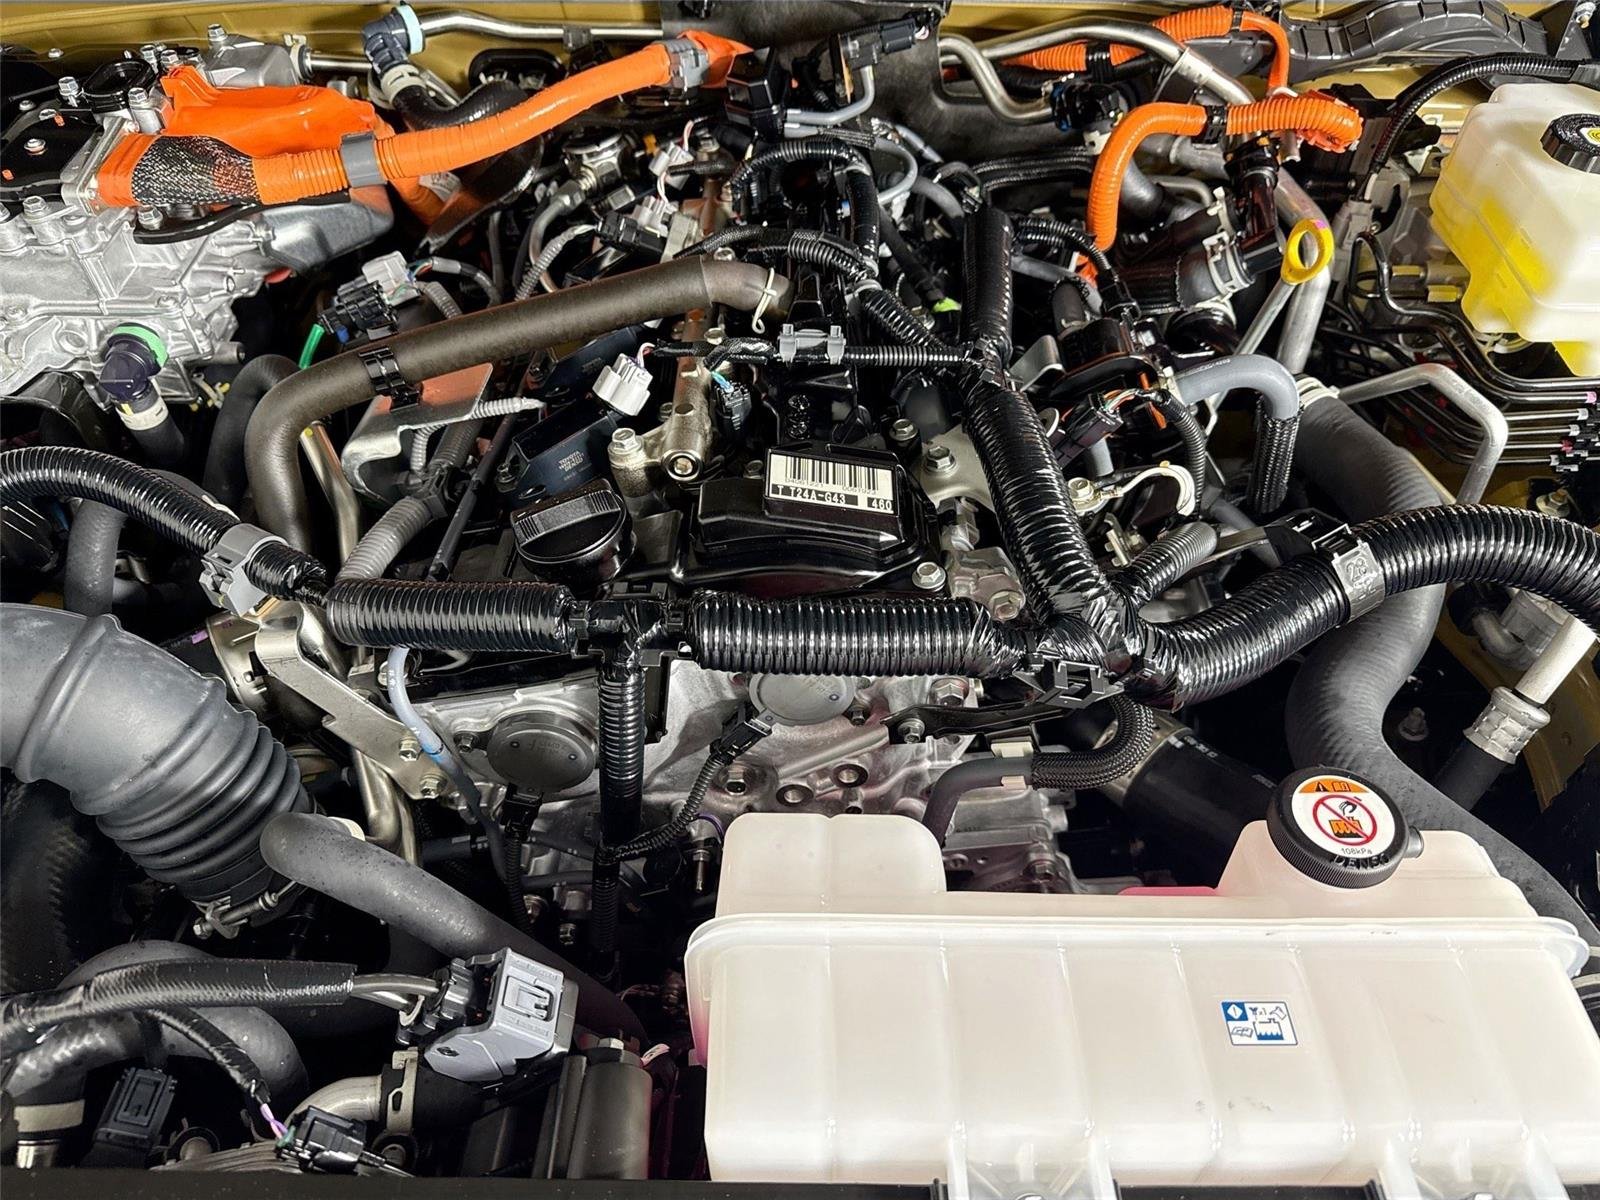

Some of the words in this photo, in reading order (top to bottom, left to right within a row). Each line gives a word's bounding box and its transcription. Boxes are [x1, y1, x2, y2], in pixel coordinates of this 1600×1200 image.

[777, 485, 785, 496] T
[790, 488, 846, 505] T24A-G43
[871, 498, 893, 510] 460
[1341, 847, 1373, 855] 108kPa
